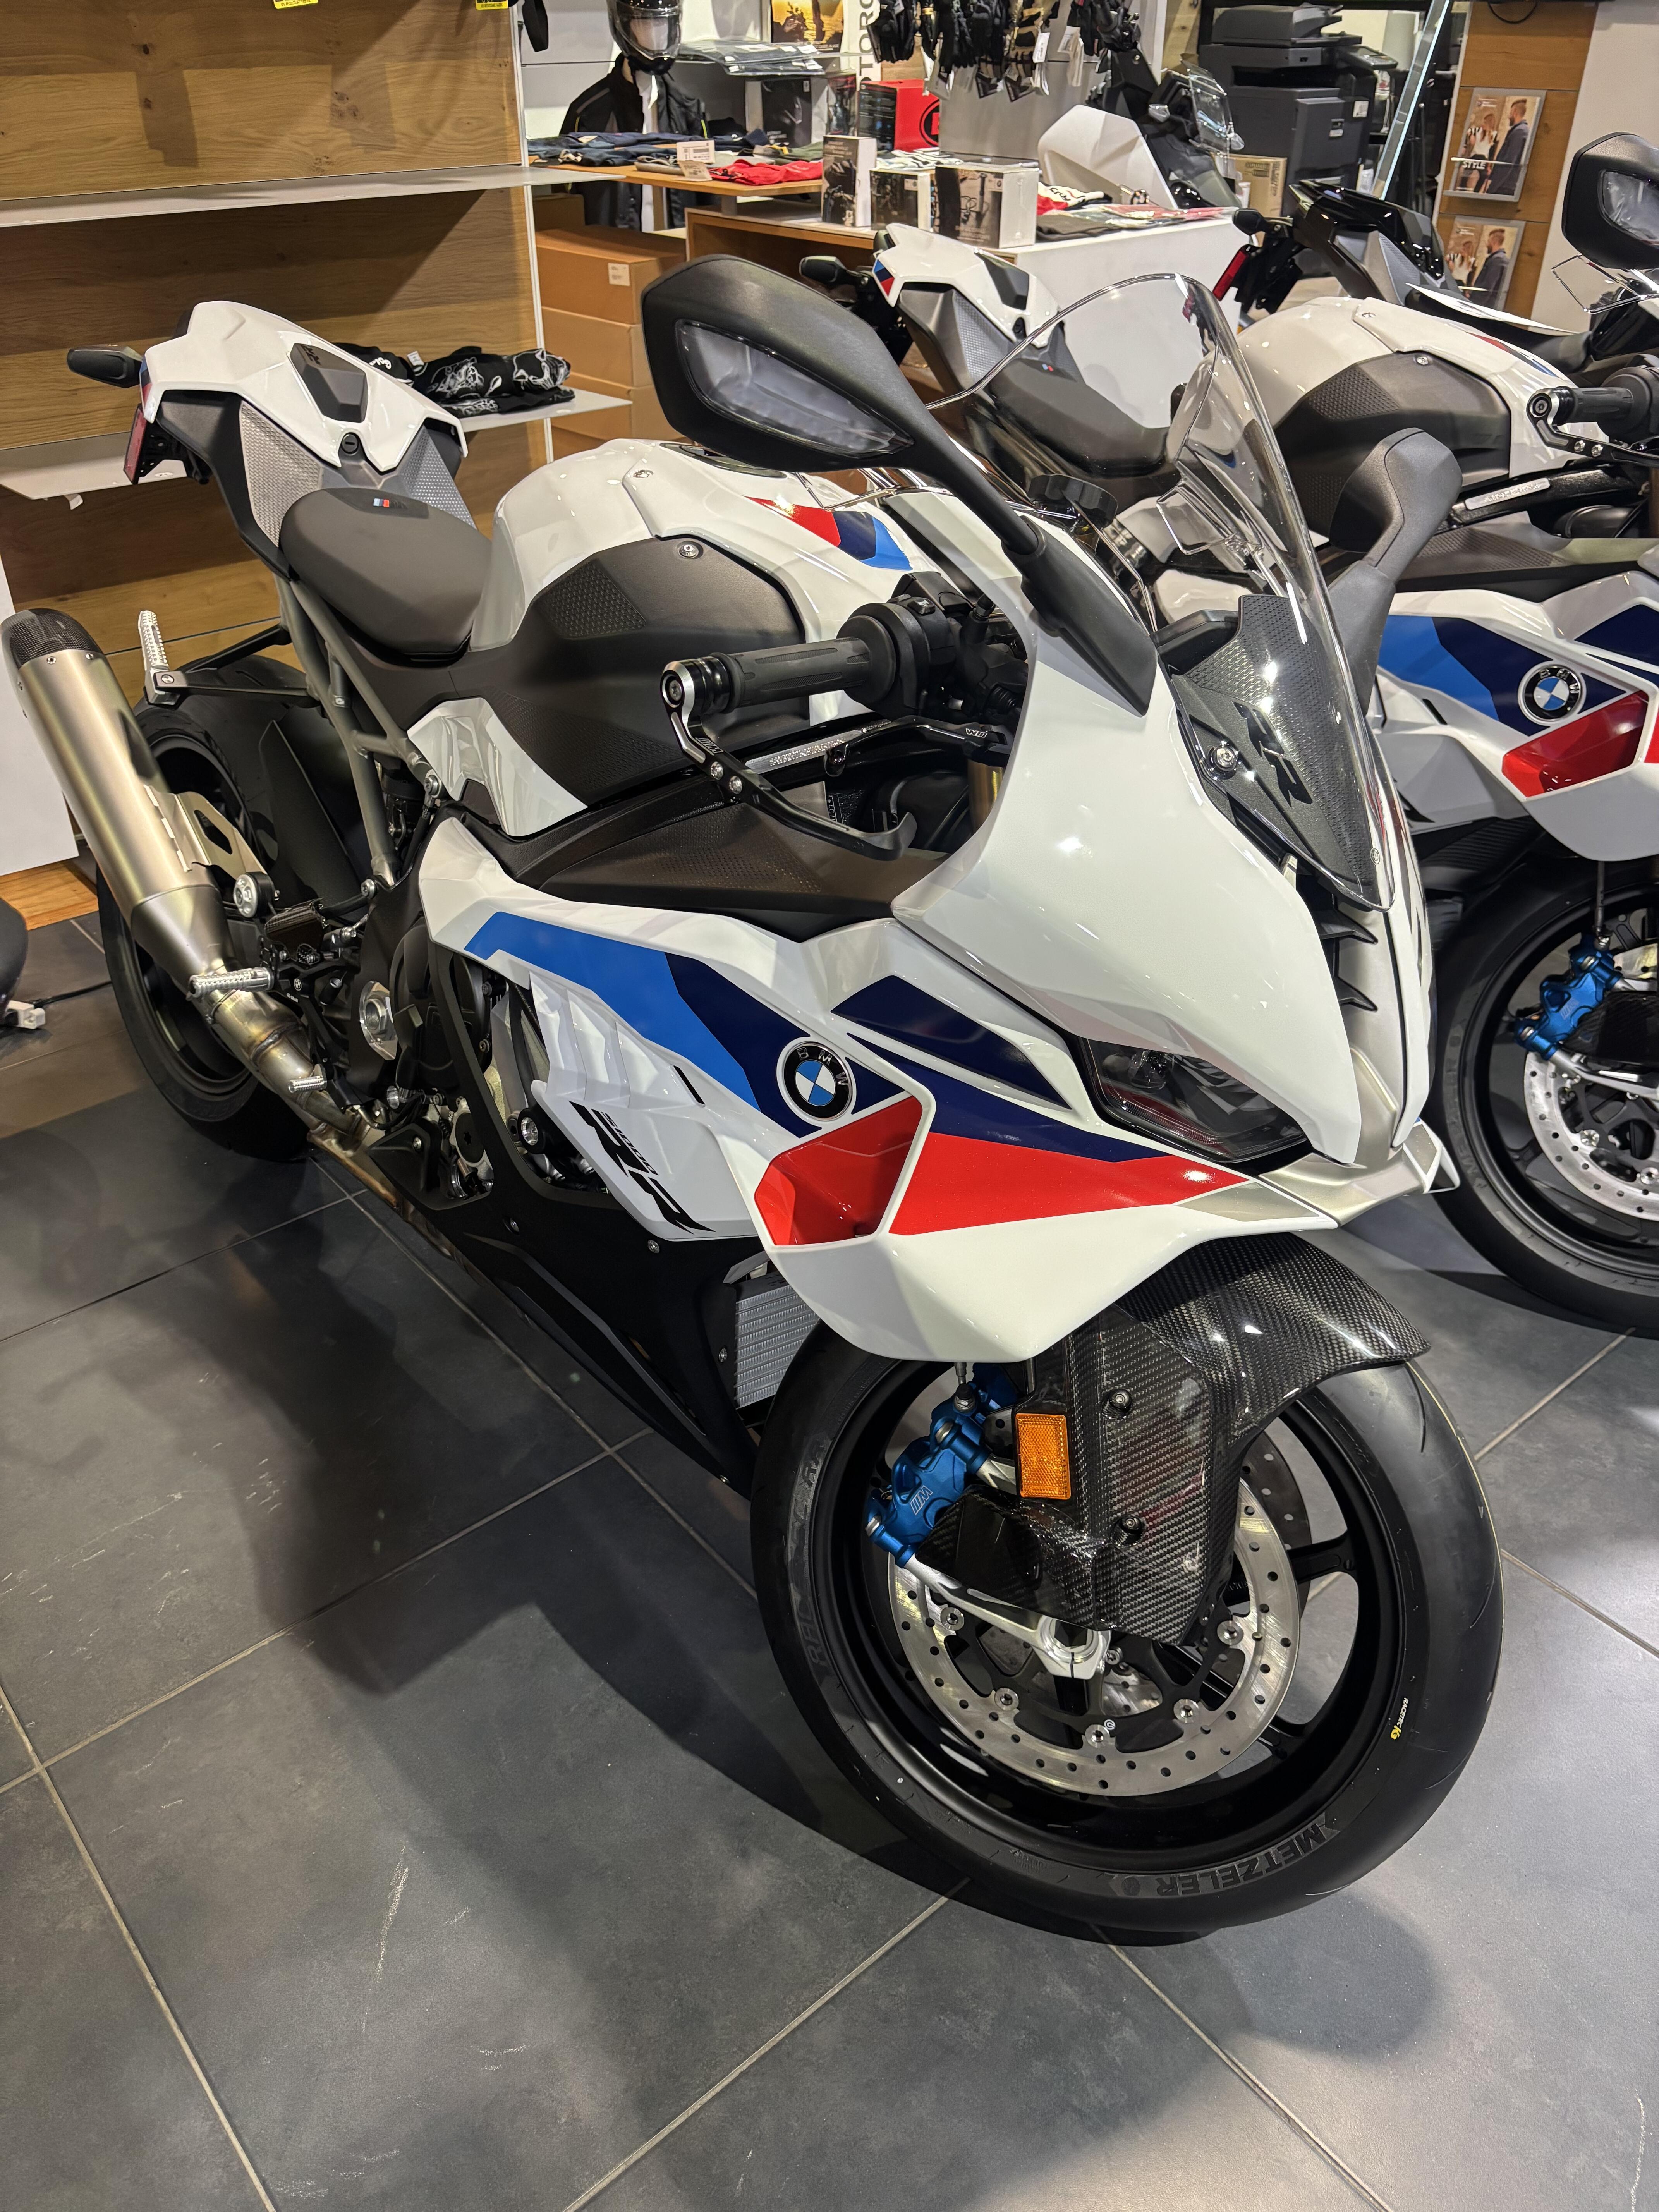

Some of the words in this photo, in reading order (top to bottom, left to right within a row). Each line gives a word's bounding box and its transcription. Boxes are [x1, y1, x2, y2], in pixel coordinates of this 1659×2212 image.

[1462, 161, 1487, 170] STYLE
[1396, 1697, 1409, 1728] RACETEC
[1156, 1822, 1327, 1896] METZELER
